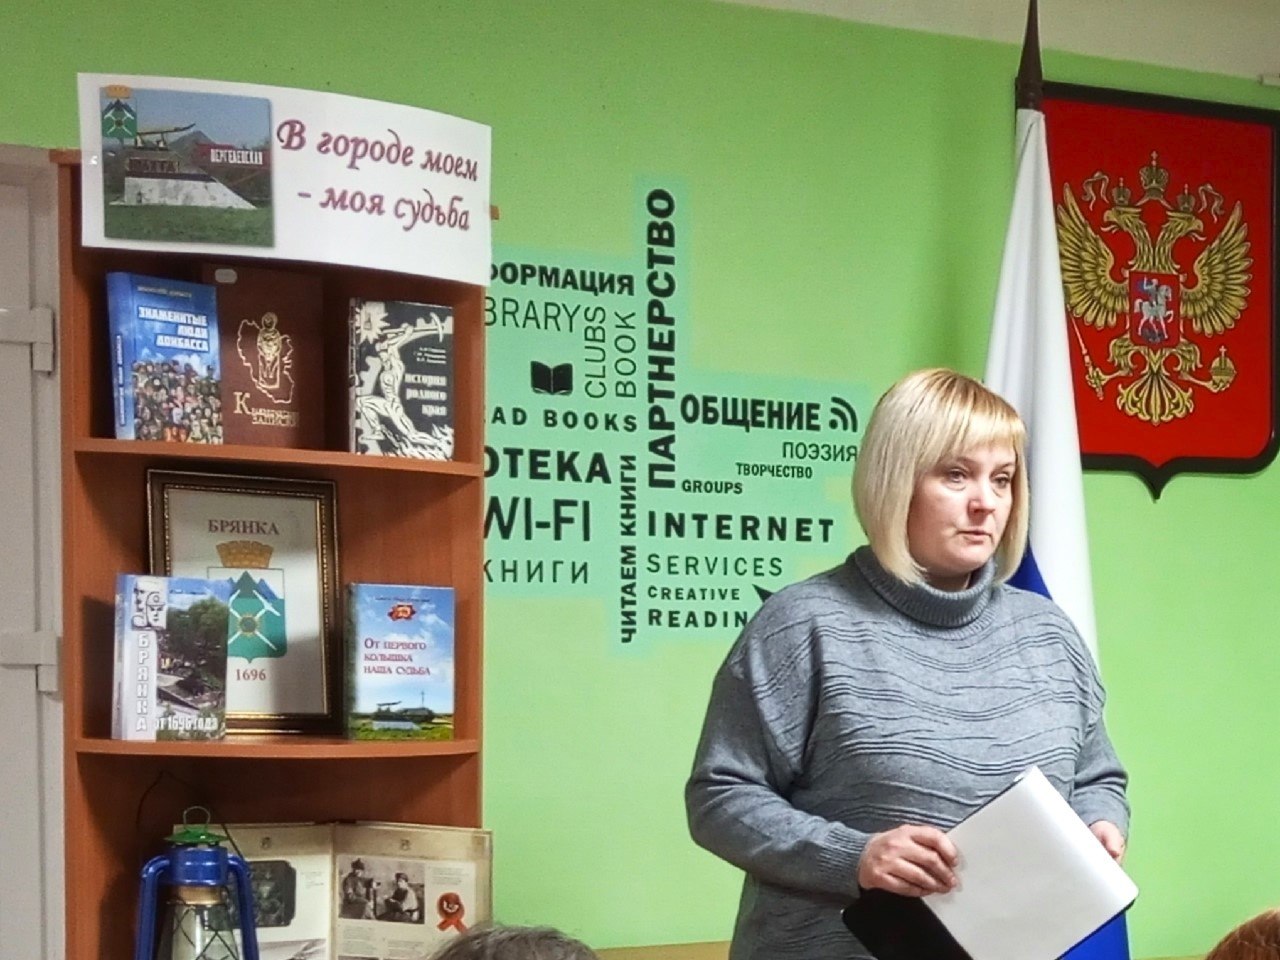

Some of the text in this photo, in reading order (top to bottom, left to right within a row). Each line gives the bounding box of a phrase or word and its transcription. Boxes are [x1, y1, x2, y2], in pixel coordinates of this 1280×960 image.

[277, 119, 479, 182] В городе моем
[319, 187, 386, 216] моя
[394, 188, 470, 232] судьба
[584, 306, 607, 398] CLUBS
[614, 311, 636, 398] BOOK
[646, 189, 676, 488] ПАРТНЕРСТВО
[543, 409, 637, 432] BOOKS
[680, 393, 821, 433] ОБЩЕНИЕ
[782, 441, 858, 462] ПОЭЗИЯ
[681, 479, 743, 494] GROUPS
[735, 462, 813, 479] ТВОРЧЕСТВО
[207, 519, 280, 536] БРЯНКА
[648, 510, 834, 543] INTERNET
[620, 455, 637, 644] ЧИТАЕМ КНИГИ
[646, 553, 782, 577] SERVICES
[647, 586, 740, 600] CREATIVE
[135, 632, 149, 733] БРЯНКА
[235, 668, 267, 682] 1696
